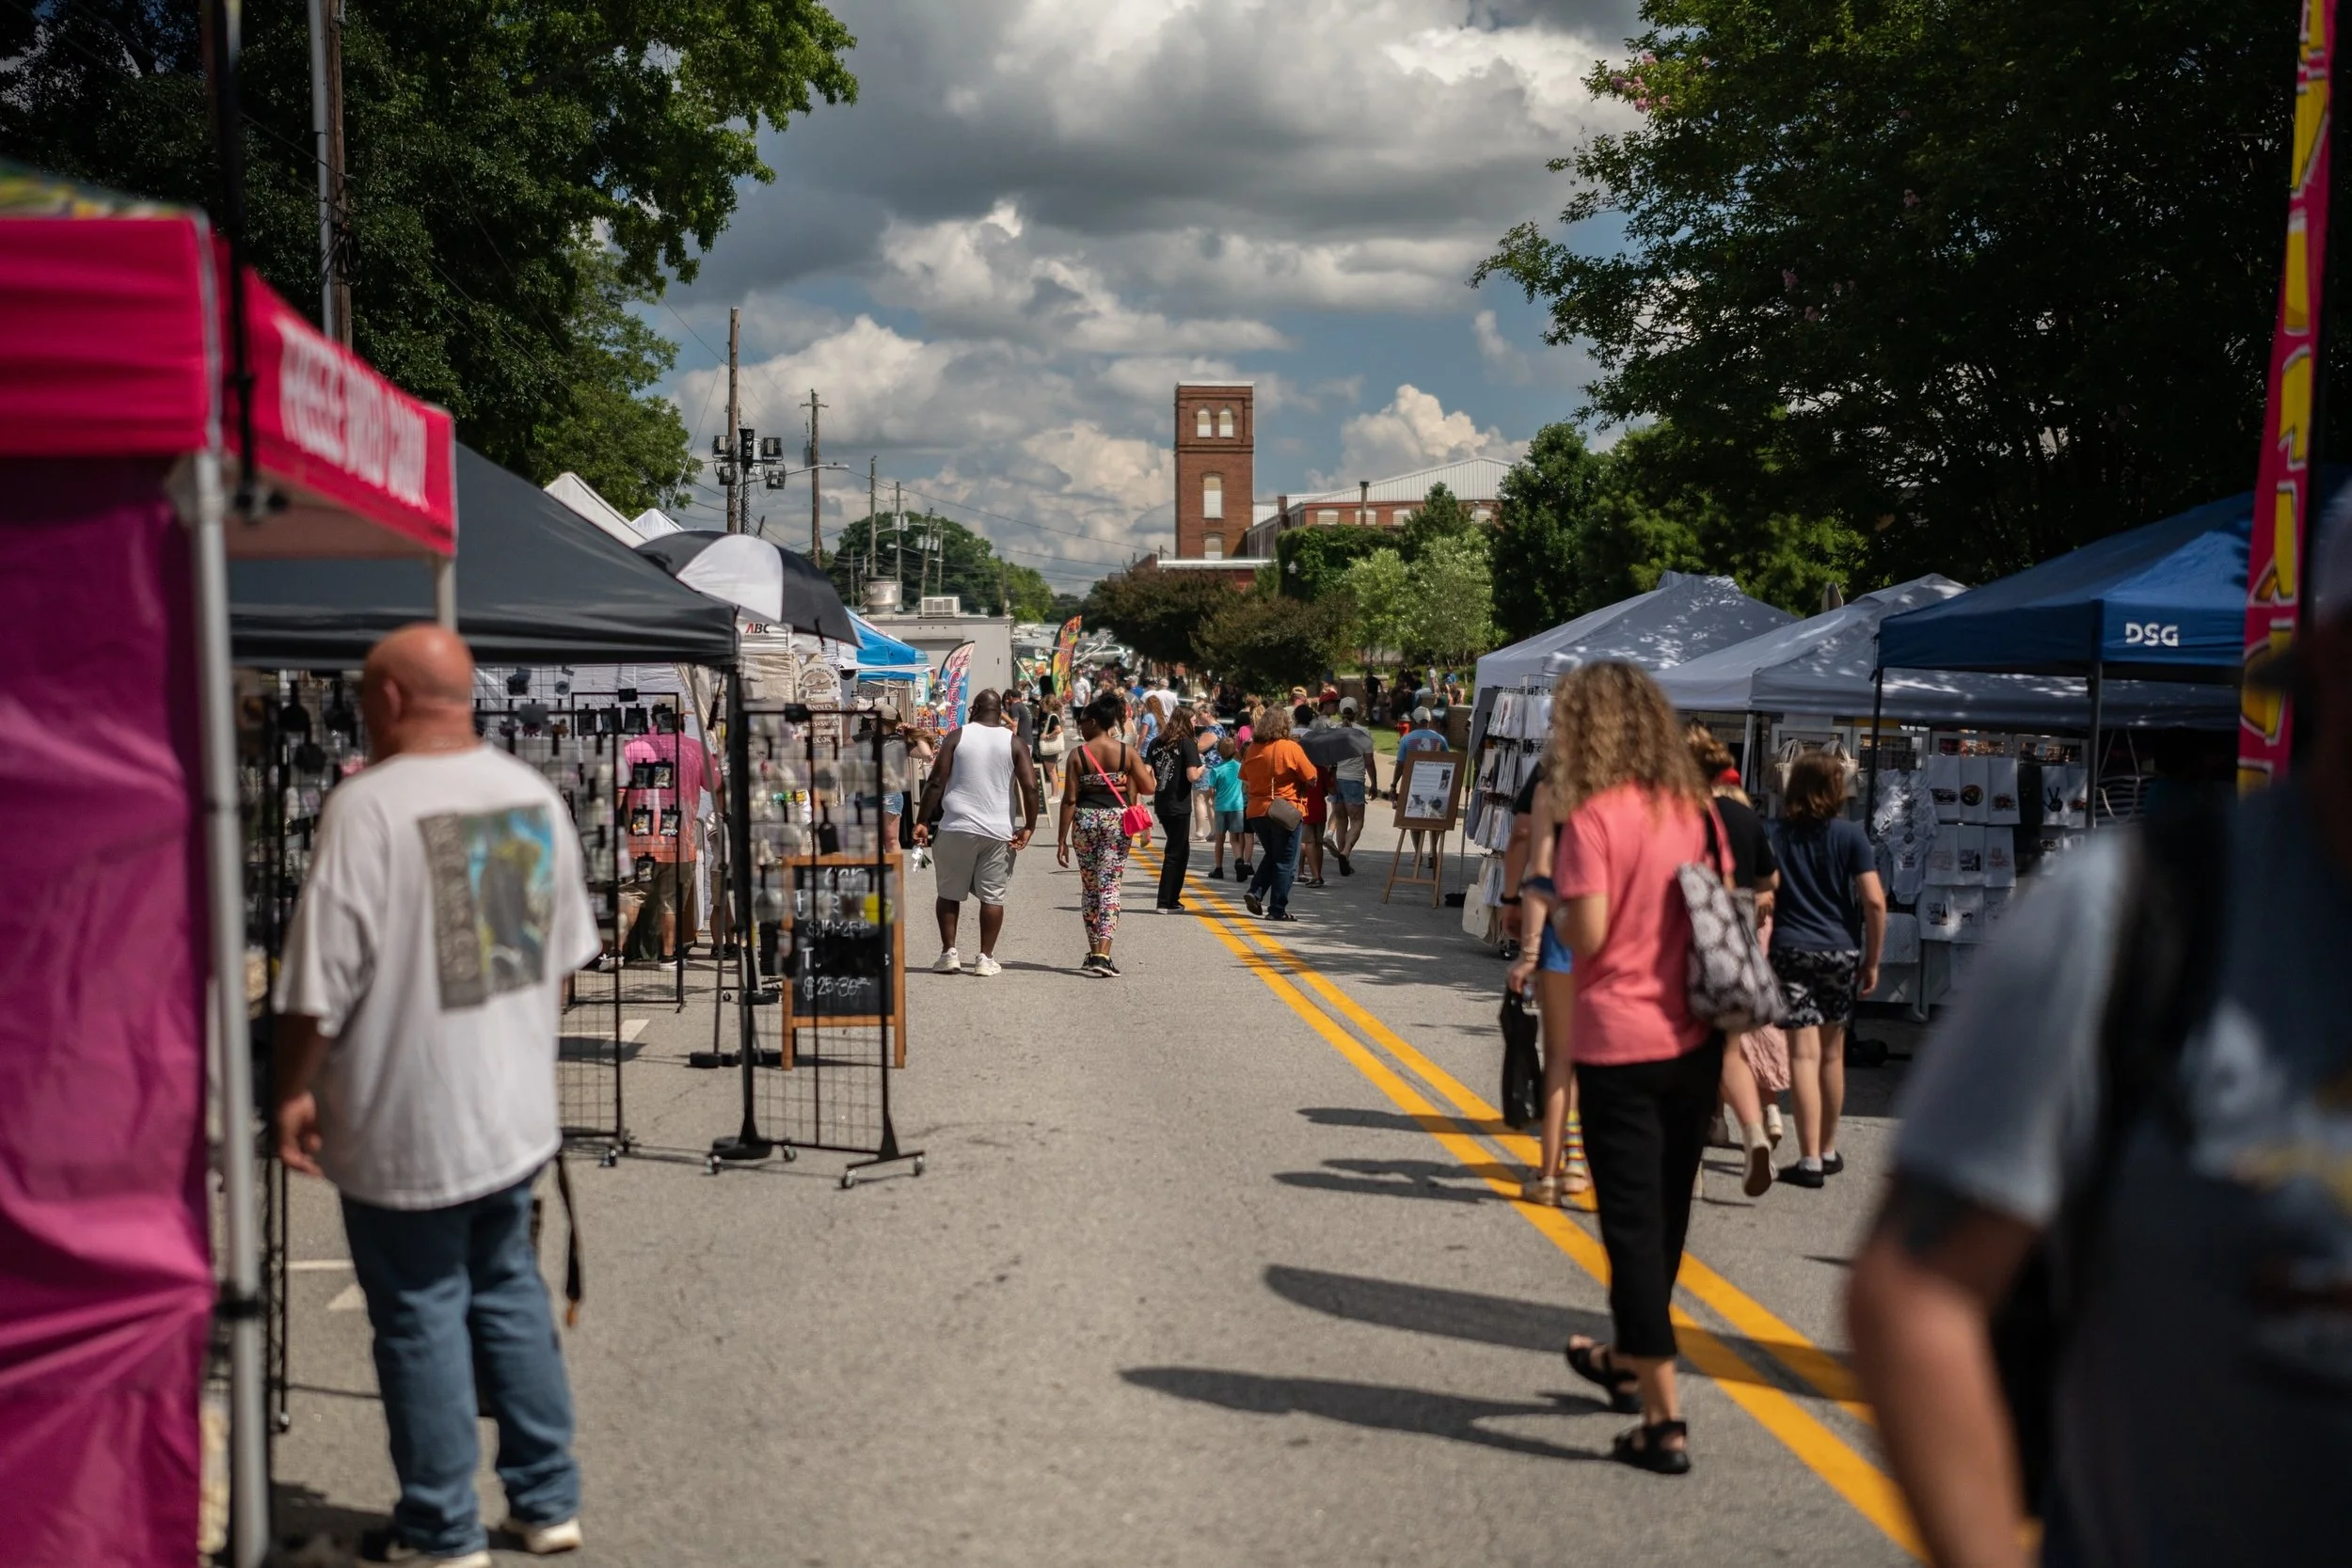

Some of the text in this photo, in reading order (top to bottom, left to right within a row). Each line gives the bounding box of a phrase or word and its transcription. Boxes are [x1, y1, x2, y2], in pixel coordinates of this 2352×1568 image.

[745, 623, 771, 634] ABC
[2125, 623, 2179, 647] DSG
[946, 671, 961, 733] CREA
